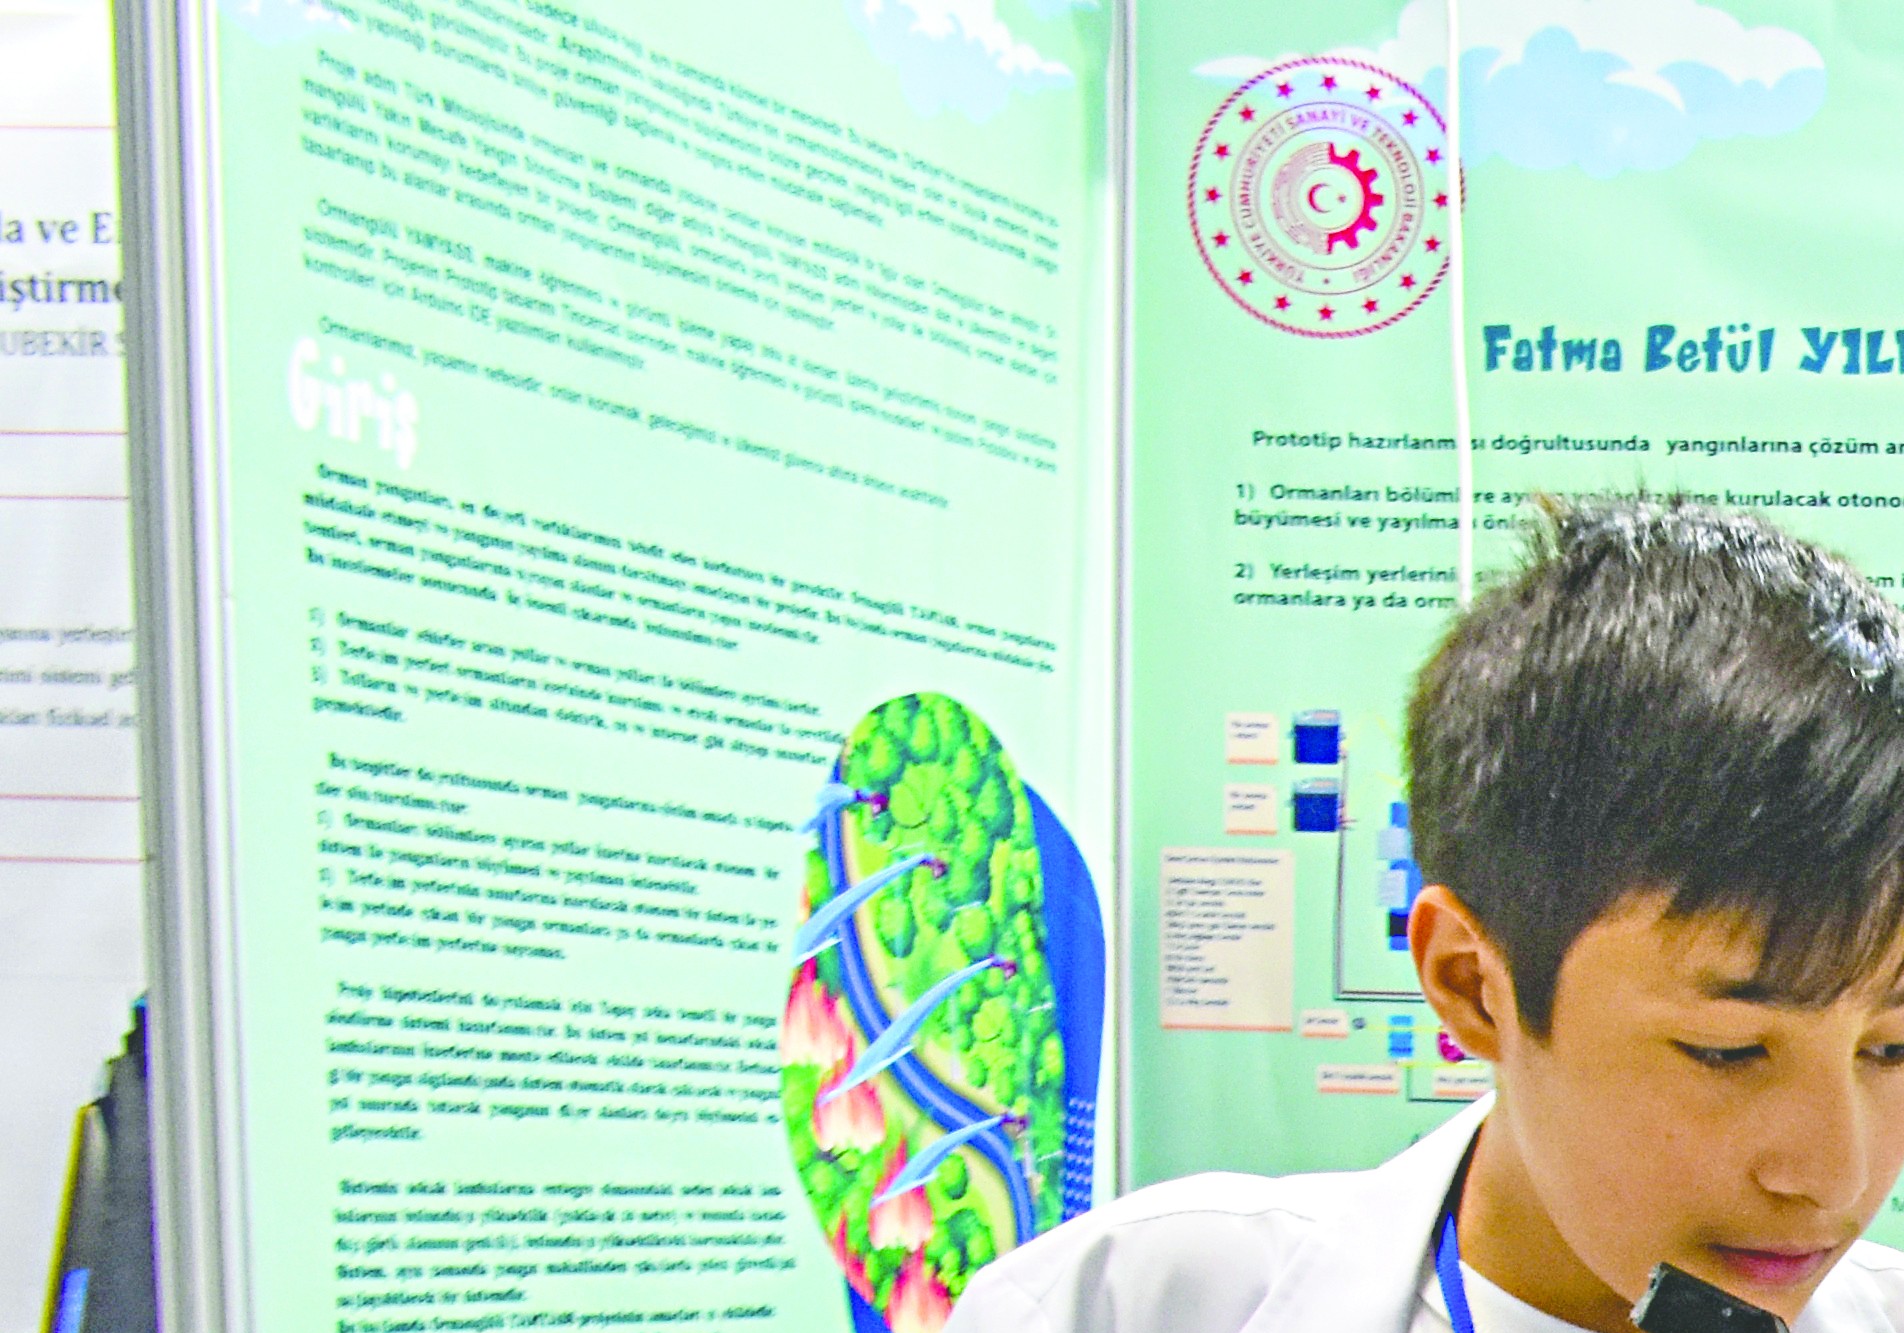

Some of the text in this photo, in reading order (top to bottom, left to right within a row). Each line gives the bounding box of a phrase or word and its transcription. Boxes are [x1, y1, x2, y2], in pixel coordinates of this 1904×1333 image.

[92, 211, 122, 244] E
[1483, 324, 1622, 373] Fatma
[1645, 322, 1776, 373] Betül
[1252, 430, 1340, 451] Prototip
[1349, 432, 1486, 452] hazırlanmsı
[1491, 434, 1650, 456] doğrultusunda
[1666, 436, 1801, 457] yangınlarına
[1809, 437, 1878, 459] çözüm
[1271, 484, 1380, 503] Ormanları
[1386, 485, 1494, 505] bölümlre
[1725, 489, 1831, 508] kurulacak
[1234, 509, 1341, 532] büyümesi
[1348, 513, 1370, 530] ve
[1270, 563, 1360, 584] Yerleşim
[1366, 566, 1460, 587] yerlerini
[1234, 591, 1346, 609] ormanlara
[1353, 594, 1376, 611] ya
[1382, 590, 1407, 608] da
